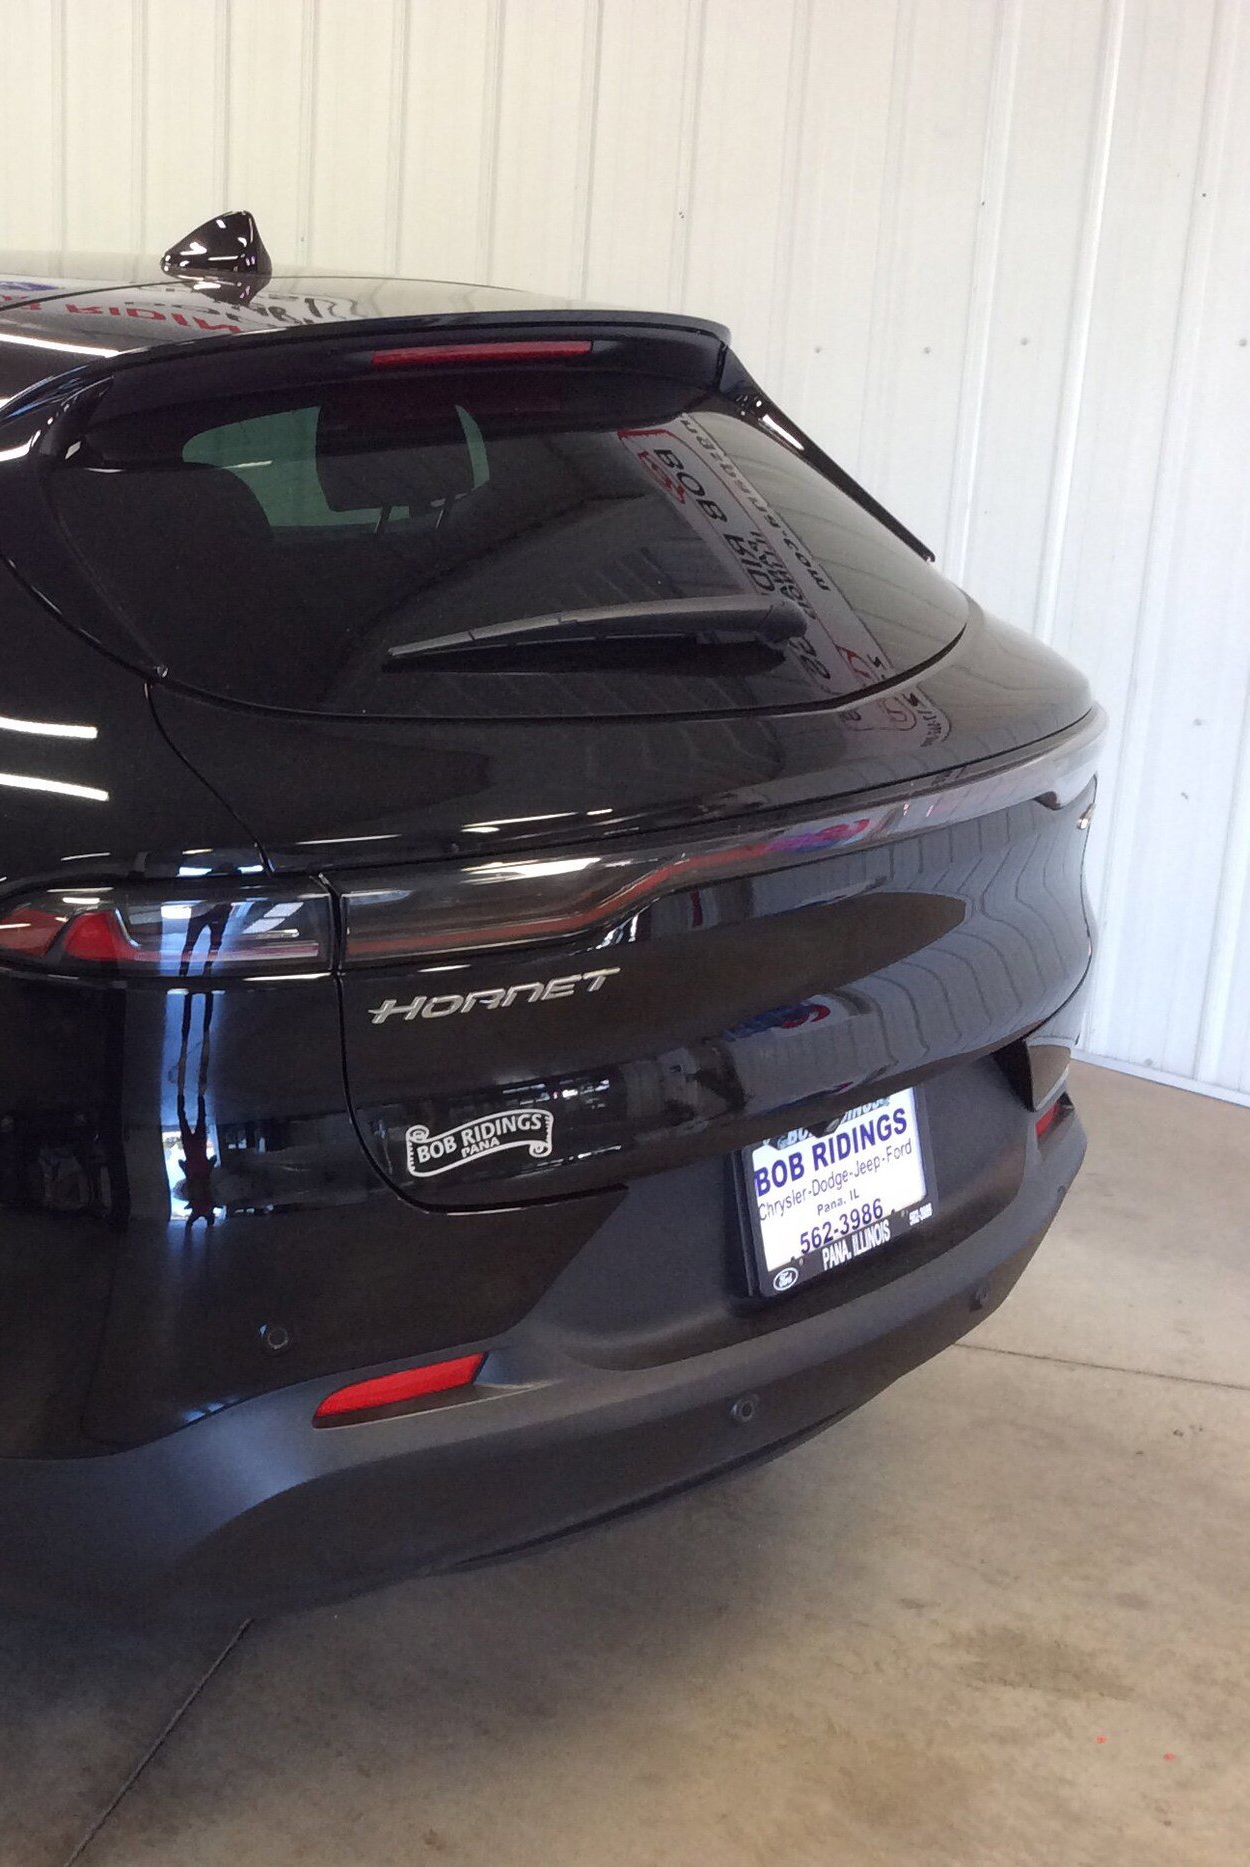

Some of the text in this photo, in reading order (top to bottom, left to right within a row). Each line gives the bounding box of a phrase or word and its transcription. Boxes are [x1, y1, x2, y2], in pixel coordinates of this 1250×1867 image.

[368, 967, 621, 1024] HORNET
[417, 1113, 542, 1163] BOB RIDINGS
[461, 1137, 500, 1158] PANA
[754, 1152, 805, 1197] BOB
[812, 1107, 907, 1171] RIDINGS
[850, 1188, 860, 1200] IL
[800, 1198, 884, 1254] 562-3986
[852, 1219, 891, 1256] ILLINOIS
